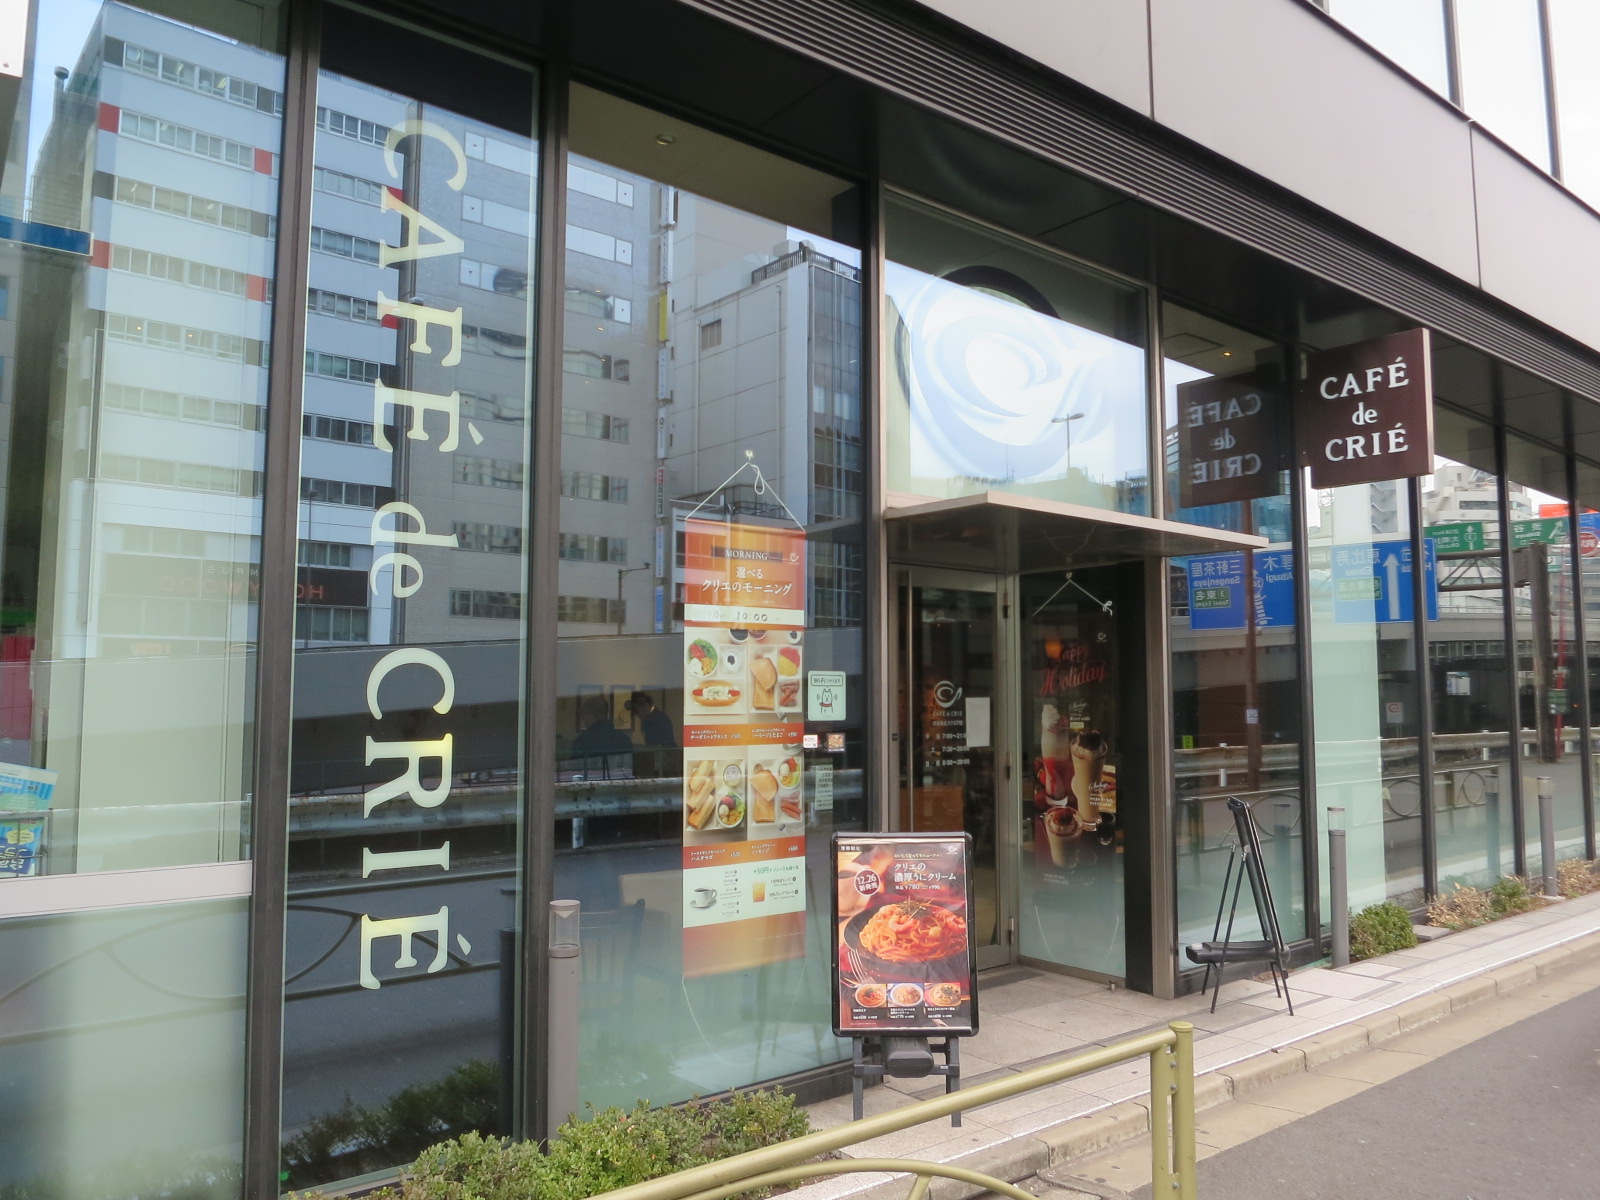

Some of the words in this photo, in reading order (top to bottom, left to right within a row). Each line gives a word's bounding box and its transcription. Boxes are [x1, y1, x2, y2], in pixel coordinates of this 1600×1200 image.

[373, 119, 483, 452] CAFÉ
[1320, 357, 1409, 399] CAFÉ
[1352, 402, 1378, 426] de
[1325, 423, 1409, 462] CRIÉ
[370, 501, 459, 598] de
[725, 549, 768, 561] MORNING
[736, 566, 763, 579] 選べる
[702, 579, 793, 596] クリエのモーニング
[1037, 662, 1106, 696] Holiday
[360, 648, 471, 989] CRIÉ
[894, 862, 926, 872] クリエの
[856, 873, 877, 885] 12.26
[858, 883, 878, 892] 新発売
[894, 872, 957, 883] 濃厚うにクリーム
